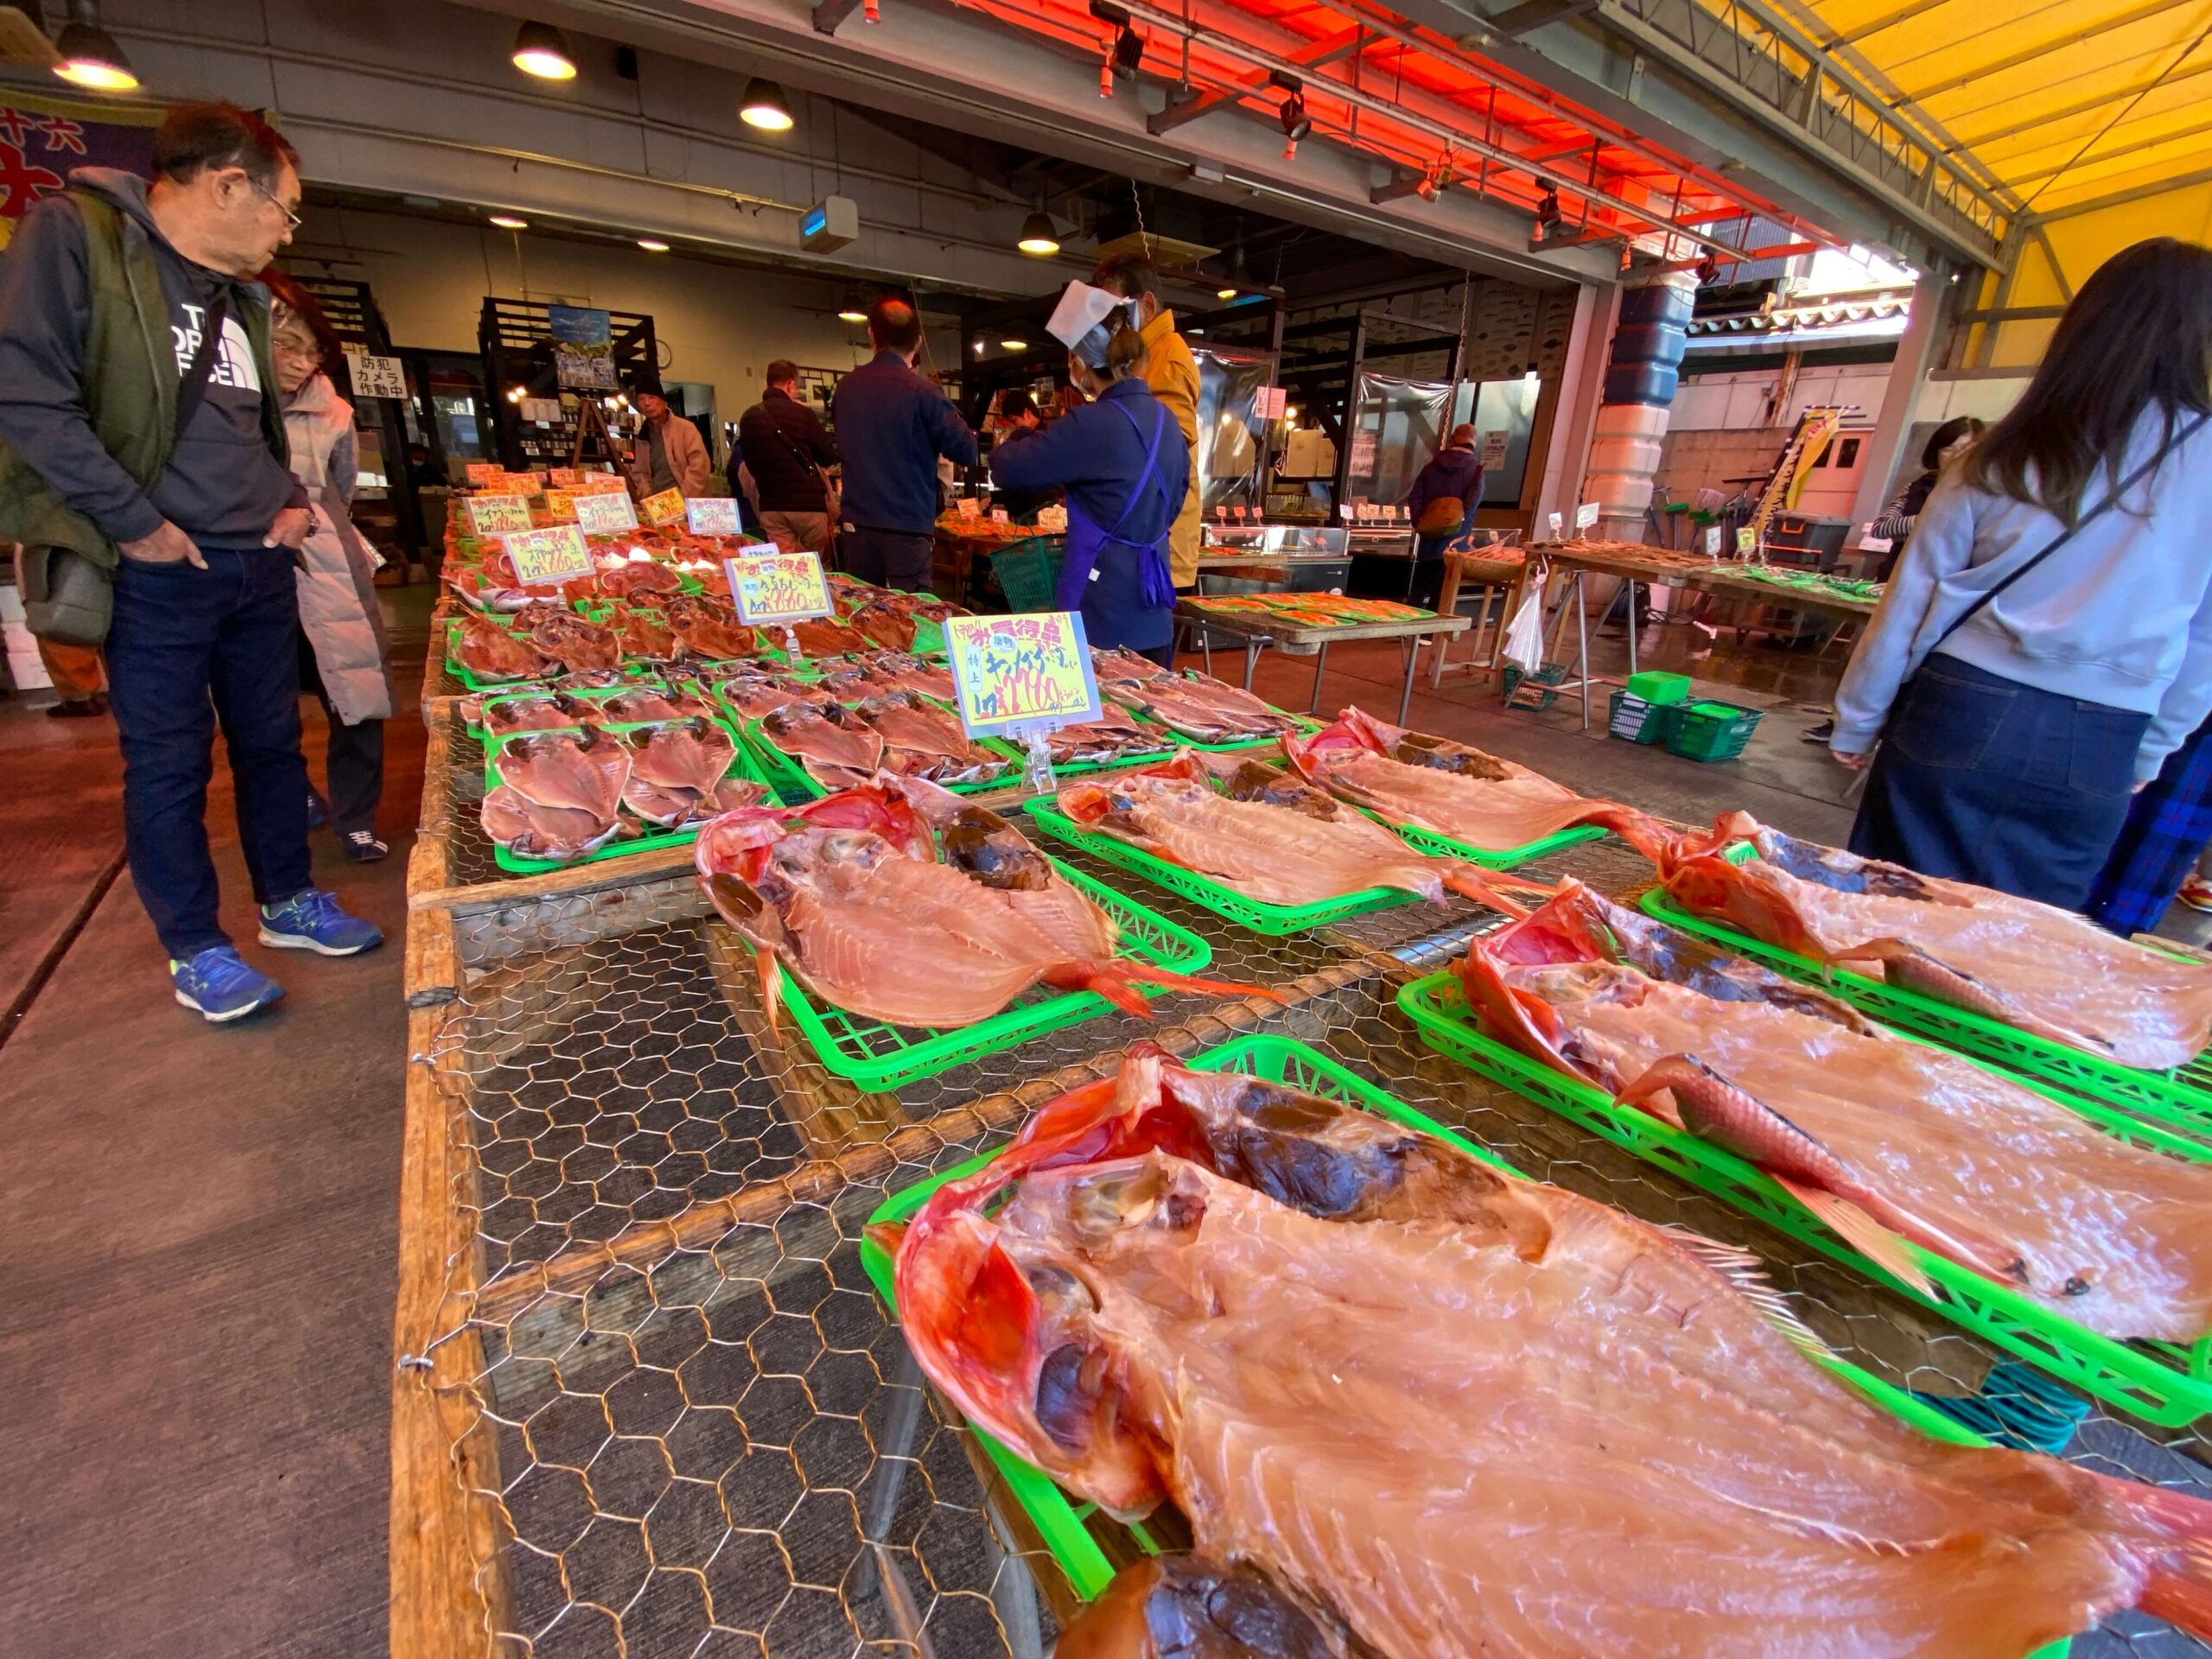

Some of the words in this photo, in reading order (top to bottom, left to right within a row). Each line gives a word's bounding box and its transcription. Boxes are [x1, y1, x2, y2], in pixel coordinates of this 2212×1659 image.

[360, 356, 391, 371] 防犯
[357, 370, 398, 385] カメラ
[359, 383, 404, 397] 作動中
